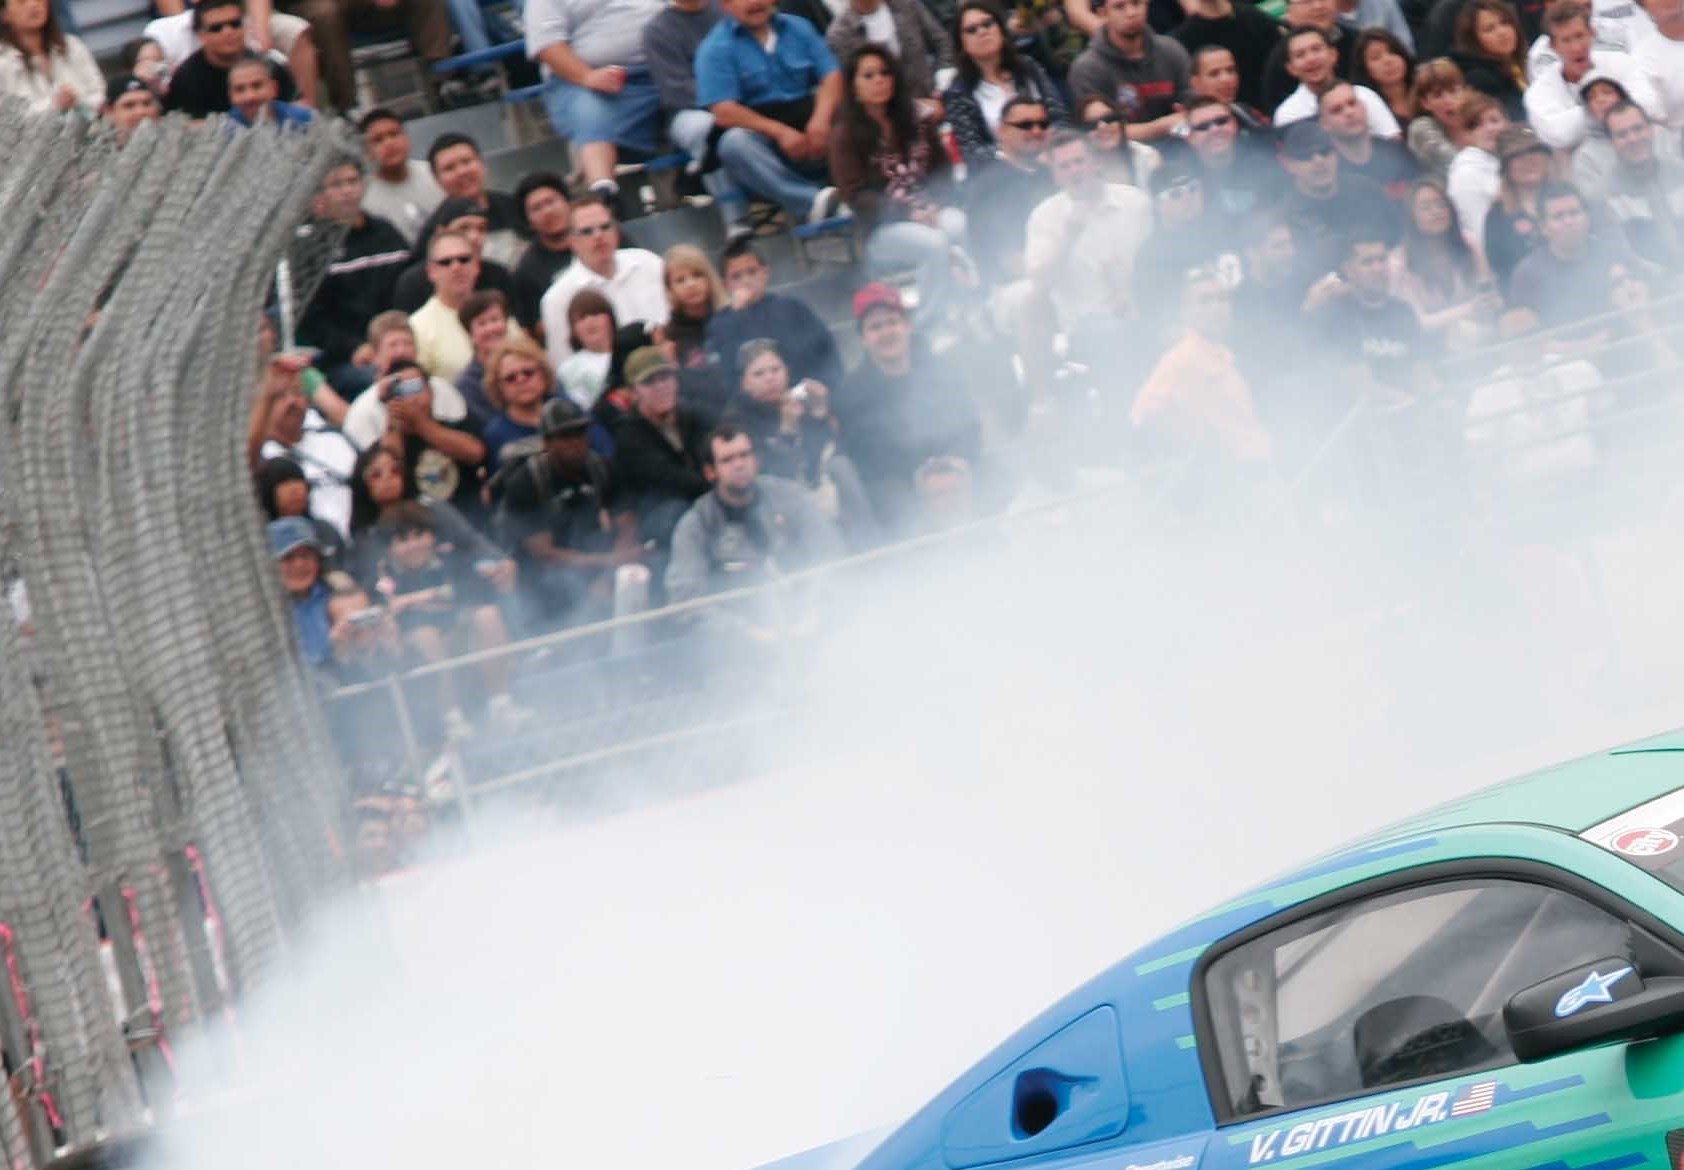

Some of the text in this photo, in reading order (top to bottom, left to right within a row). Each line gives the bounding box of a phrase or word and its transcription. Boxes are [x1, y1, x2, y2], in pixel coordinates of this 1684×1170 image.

[1248, 1092, 1448, 1164] V. GITTIN JR.
